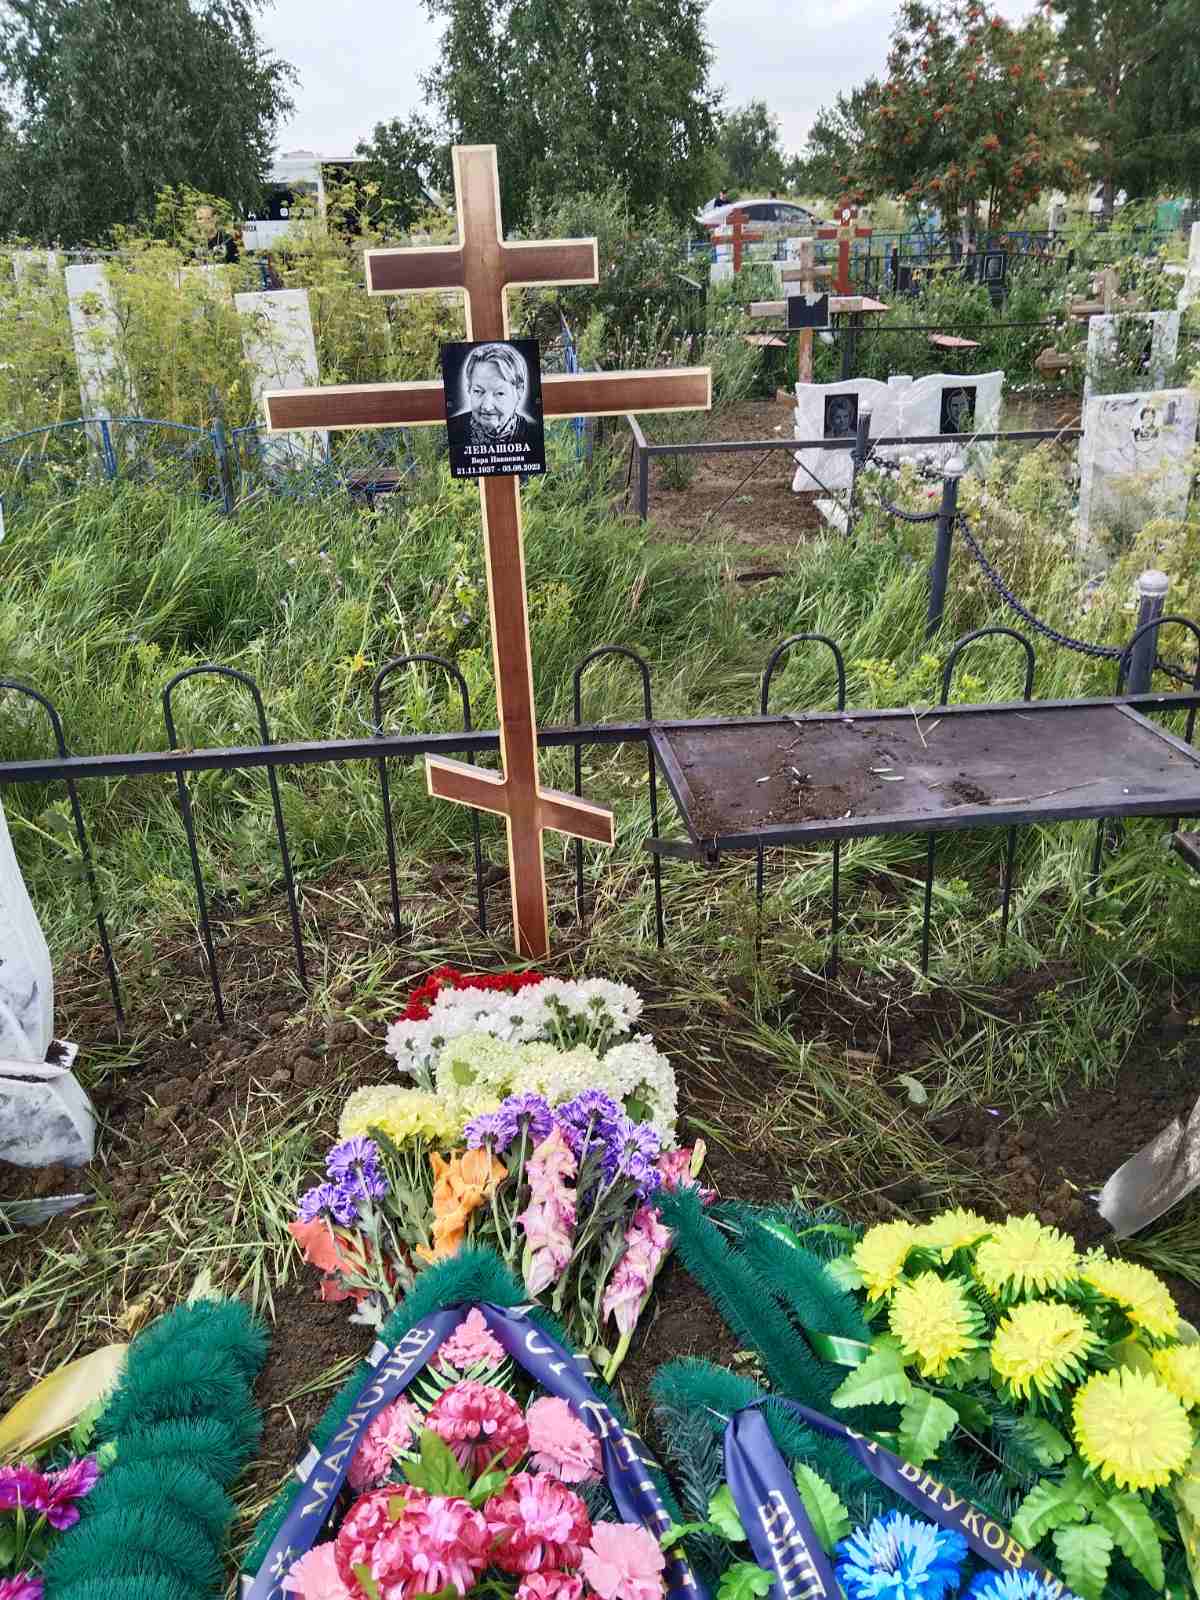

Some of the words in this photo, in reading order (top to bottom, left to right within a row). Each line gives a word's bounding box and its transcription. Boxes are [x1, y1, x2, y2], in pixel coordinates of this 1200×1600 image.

[464, 443, 531, 455] ЛЕВАШОВА
[471, 456, 489, 465] Вера
[301, 1328, 435, 1519] МАМОЧКЕ
